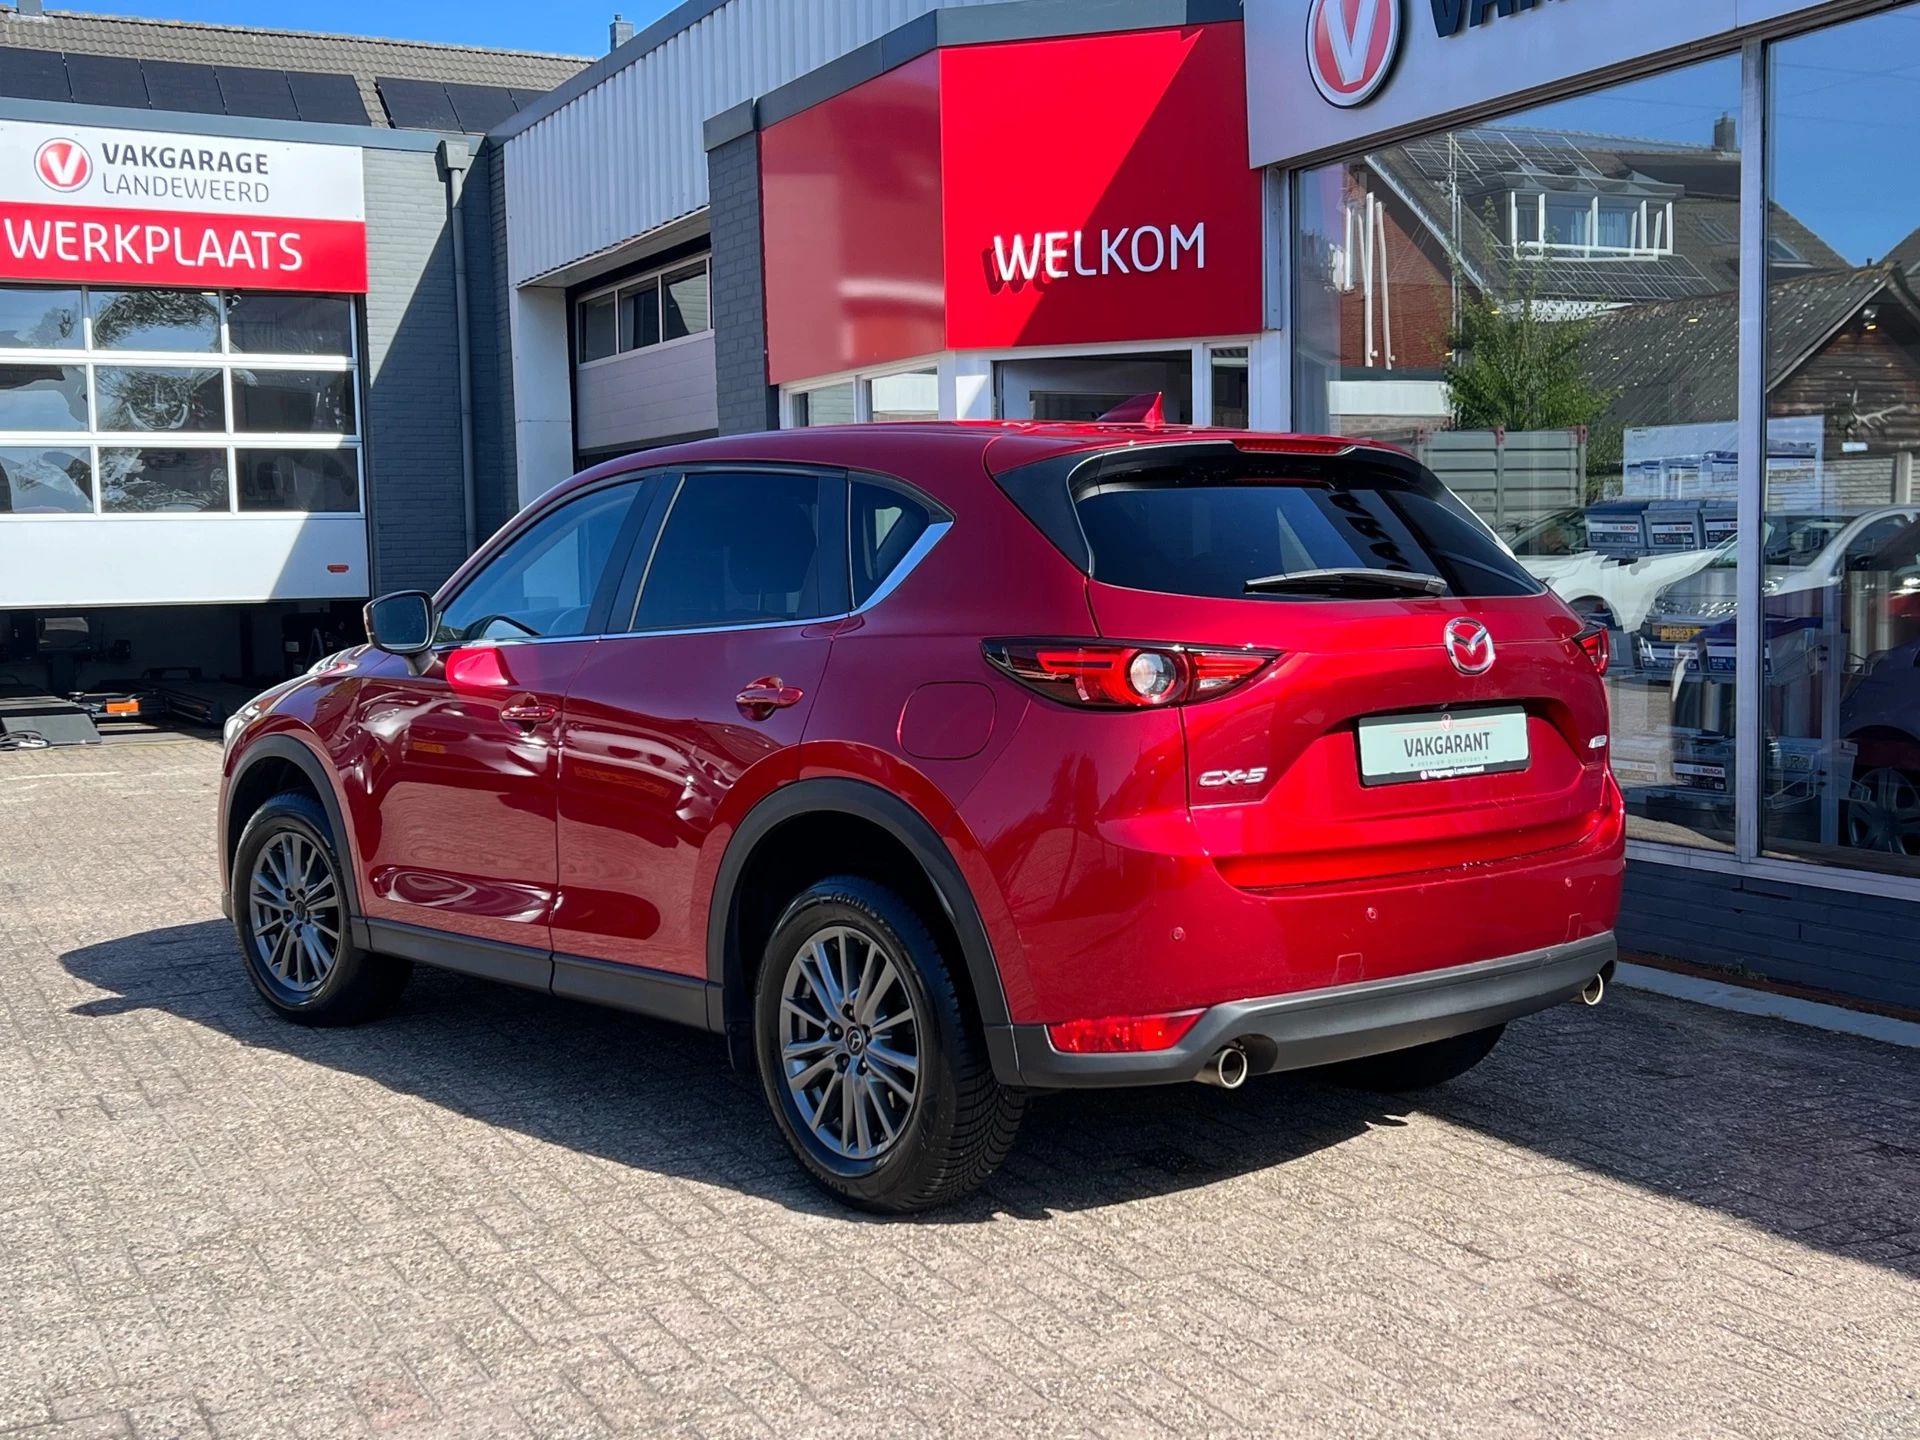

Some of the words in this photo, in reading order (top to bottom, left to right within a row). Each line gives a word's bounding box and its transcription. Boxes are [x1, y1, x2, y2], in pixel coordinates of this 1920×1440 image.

[102, 142, 269, 175] VAKGARAGE
[102, 172, 270, 203] LANDEWEERD
[4, 218, 303, 271] WERKPLAATS
[993, 222, 1204, 281] WELKOM
[1404, 732, 1490, 757] VAKGARANT
[1199, 767, 1268, 787] CX-5
[1702, 768, 1723, 776] BOSCH
